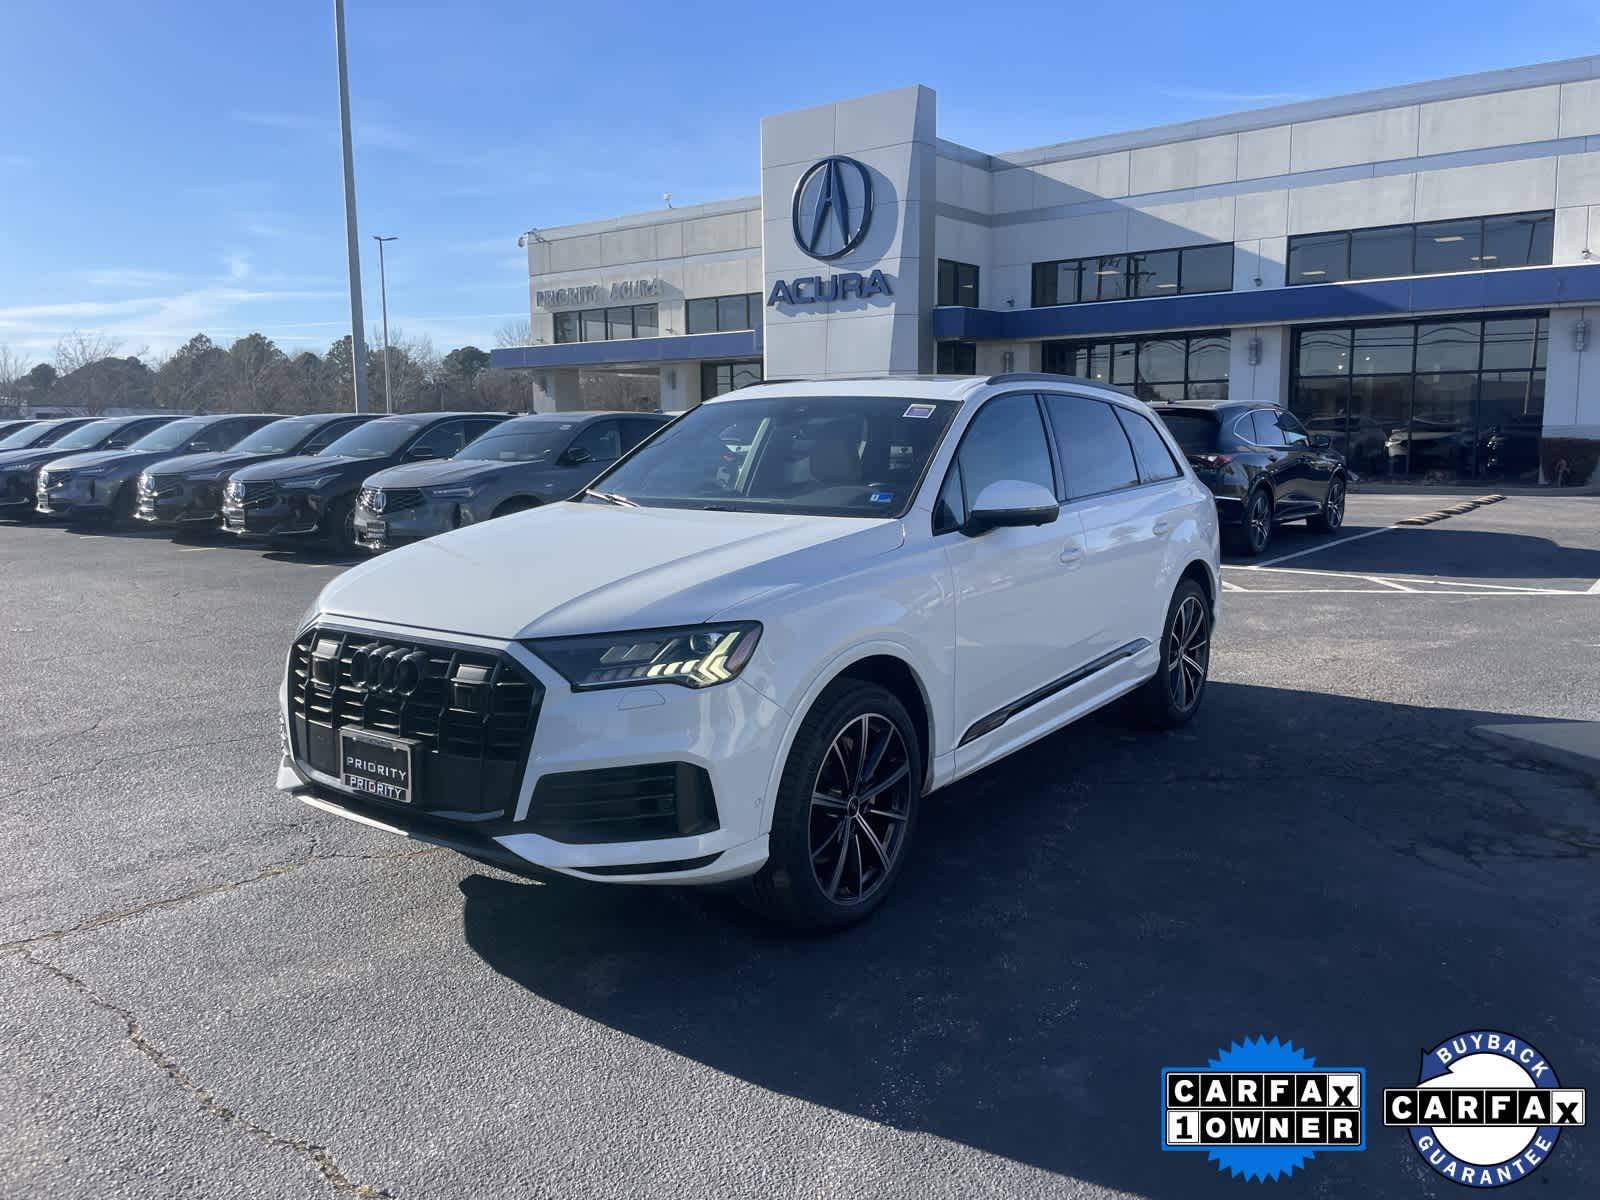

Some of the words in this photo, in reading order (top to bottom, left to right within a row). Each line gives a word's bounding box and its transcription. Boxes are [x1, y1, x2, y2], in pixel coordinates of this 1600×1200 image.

[536, 284, 600, 307] PRIORITY
[609, 277, 664, 300] ACURA
[767, 269, 894, 306] ACURA
[346, 756, 407, 781] PRIORITY
[350, 776, 402, 799] PRIORITY
